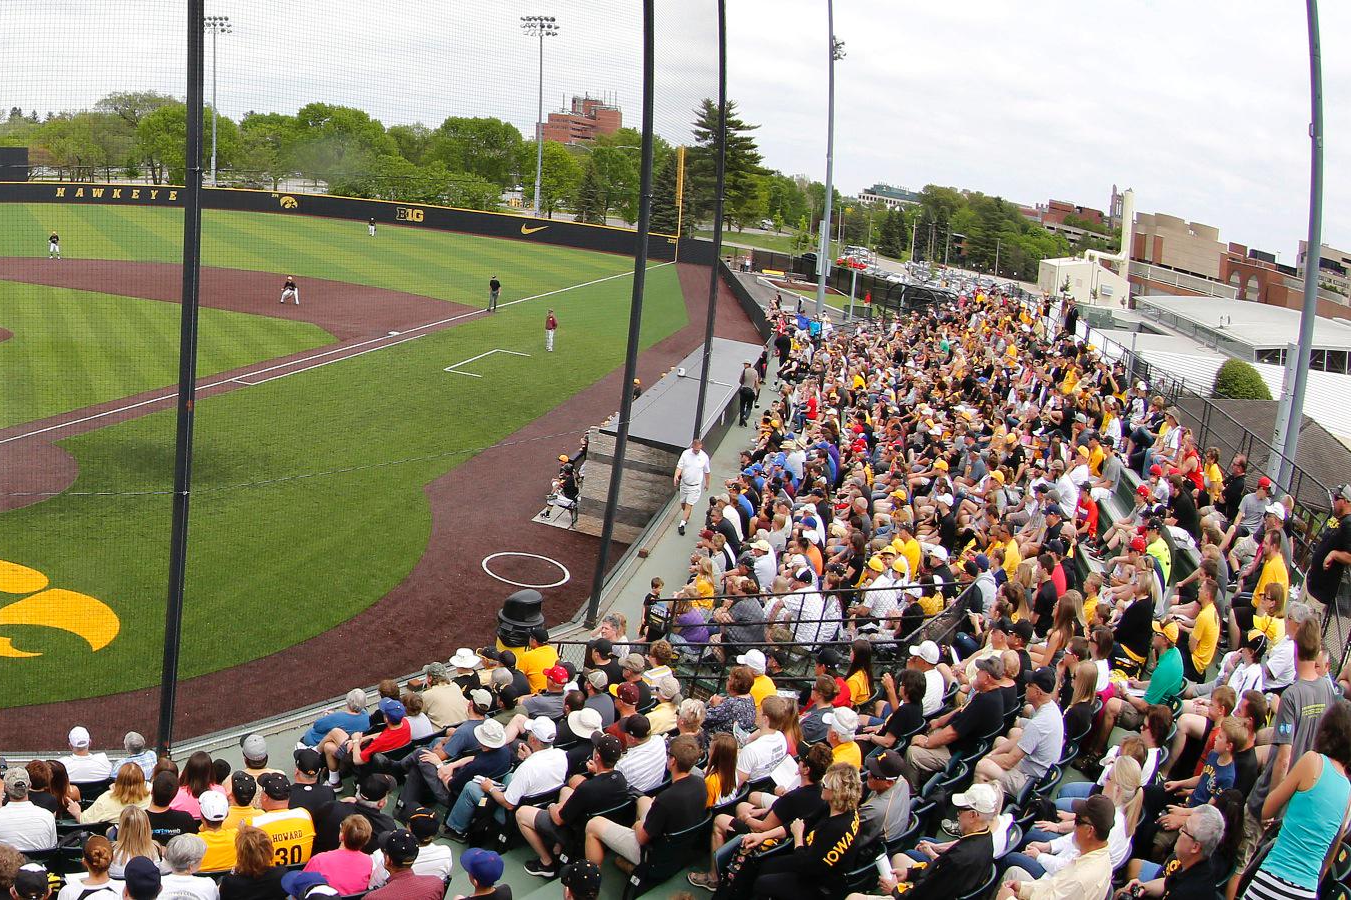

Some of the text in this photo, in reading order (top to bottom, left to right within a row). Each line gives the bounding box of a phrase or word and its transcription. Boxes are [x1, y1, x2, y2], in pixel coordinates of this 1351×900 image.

[56, 187, 178, 200] HAWKEYE
[272, 830, 302, 842] HOWARD
[274, 845, 302, 866] 30
[822, 831, 854, 867] IOWA
